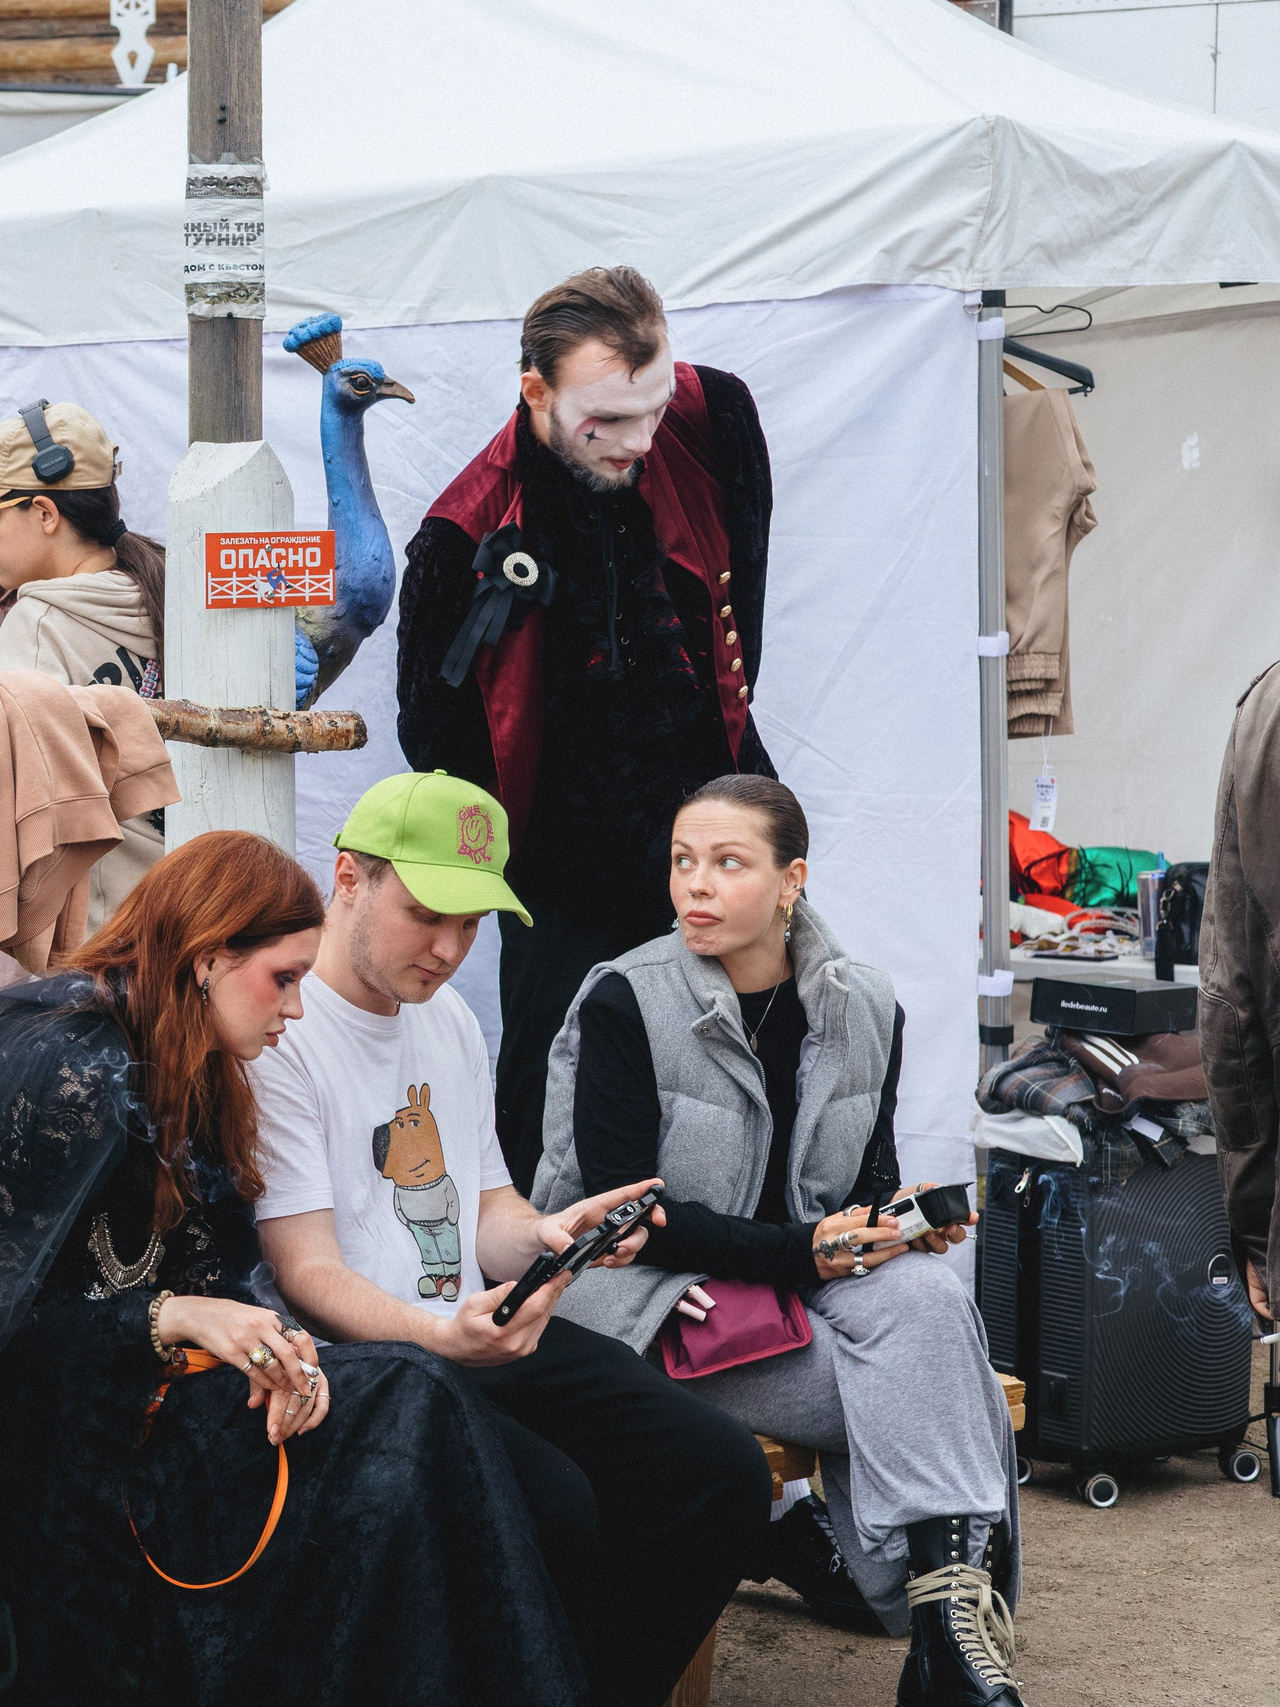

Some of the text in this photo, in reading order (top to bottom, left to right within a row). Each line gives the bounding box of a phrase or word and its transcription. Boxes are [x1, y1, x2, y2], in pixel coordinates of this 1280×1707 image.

[184, 233, 257, 247] ТУРНИР
[220, 535, 321, 545] ЗАЛЕЗАТЬ НА ОГРАЖДЕНИЕ
[220, 547, 322, 570] ОПАСНО
